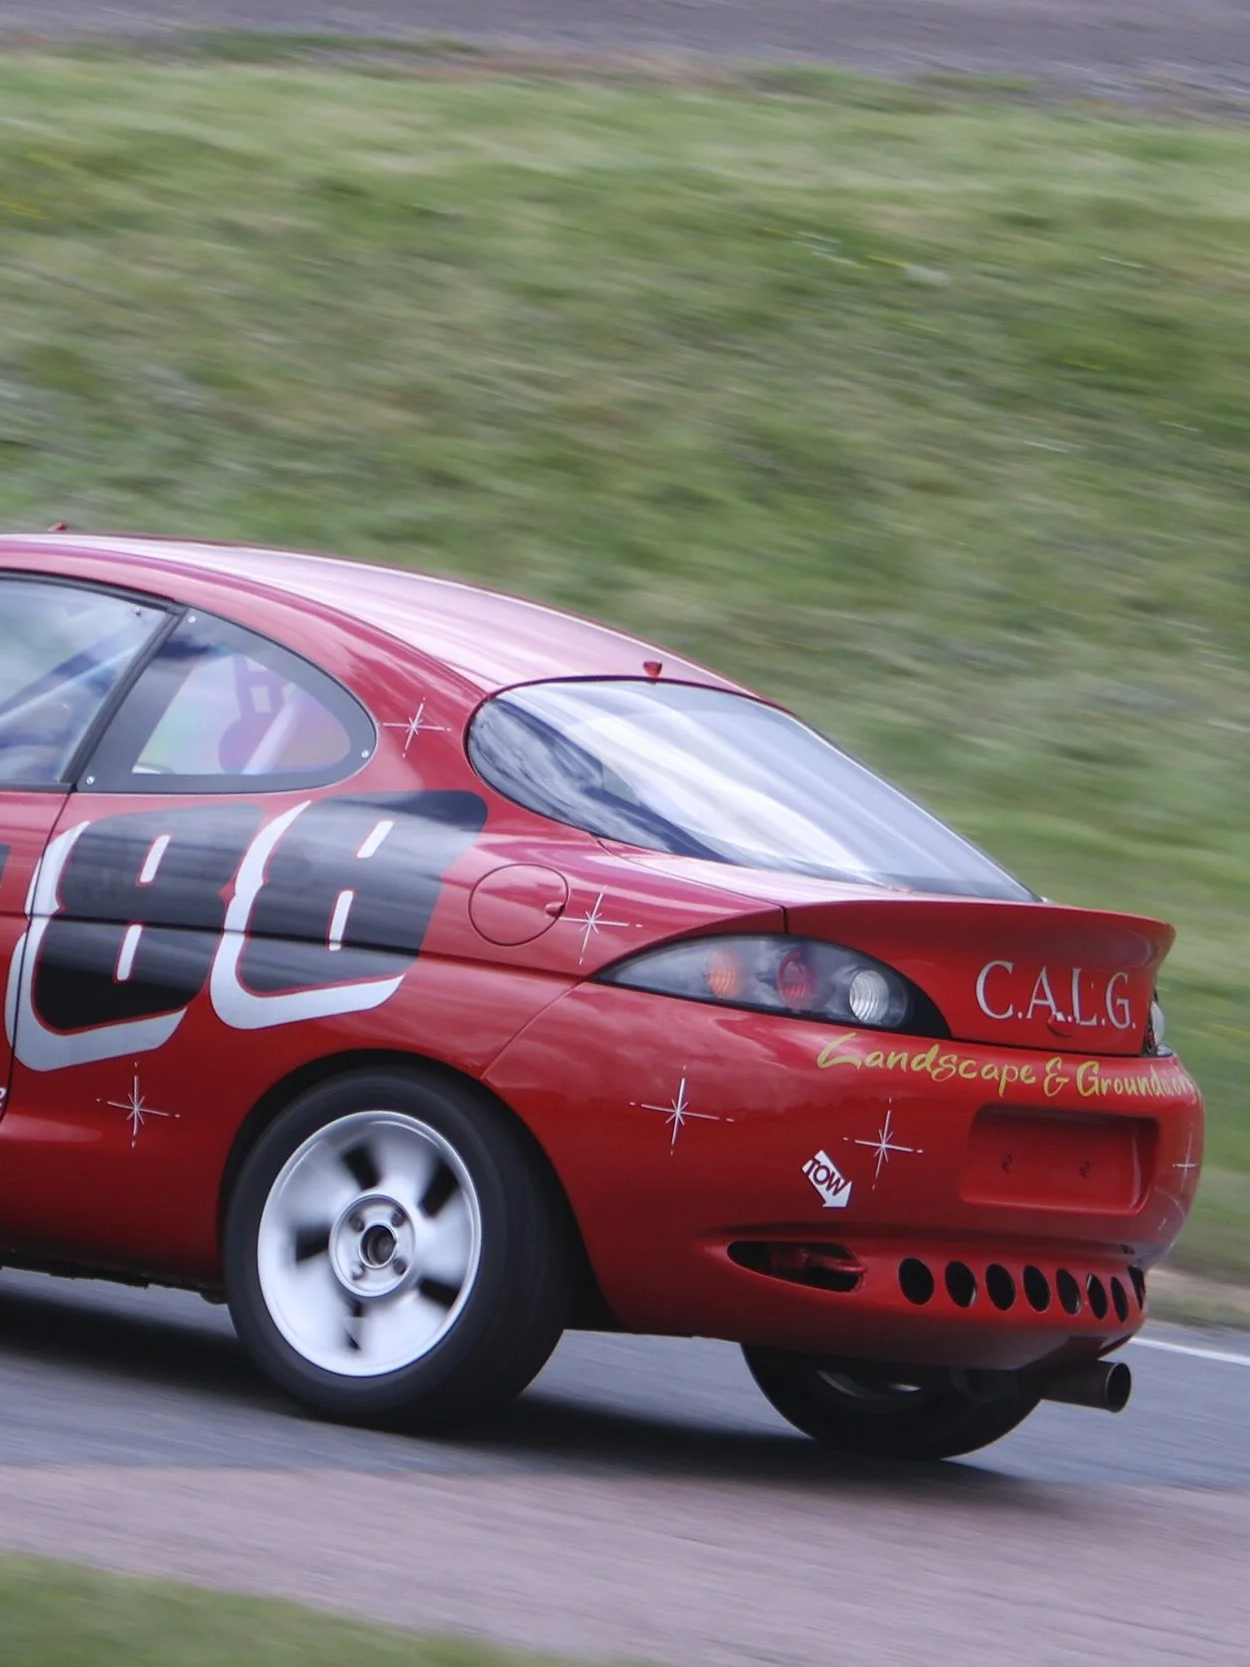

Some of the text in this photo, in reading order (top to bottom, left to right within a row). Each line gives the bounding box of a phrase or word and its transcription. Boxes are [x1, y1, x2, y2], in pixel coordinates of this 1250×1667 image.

[4, 789, 489, 1071] 88
[816, 1031, 1036, 1097] Landscape
[1043, 1056, 1070, 1097] &
[804, 1158, 849, 1197] TOW
